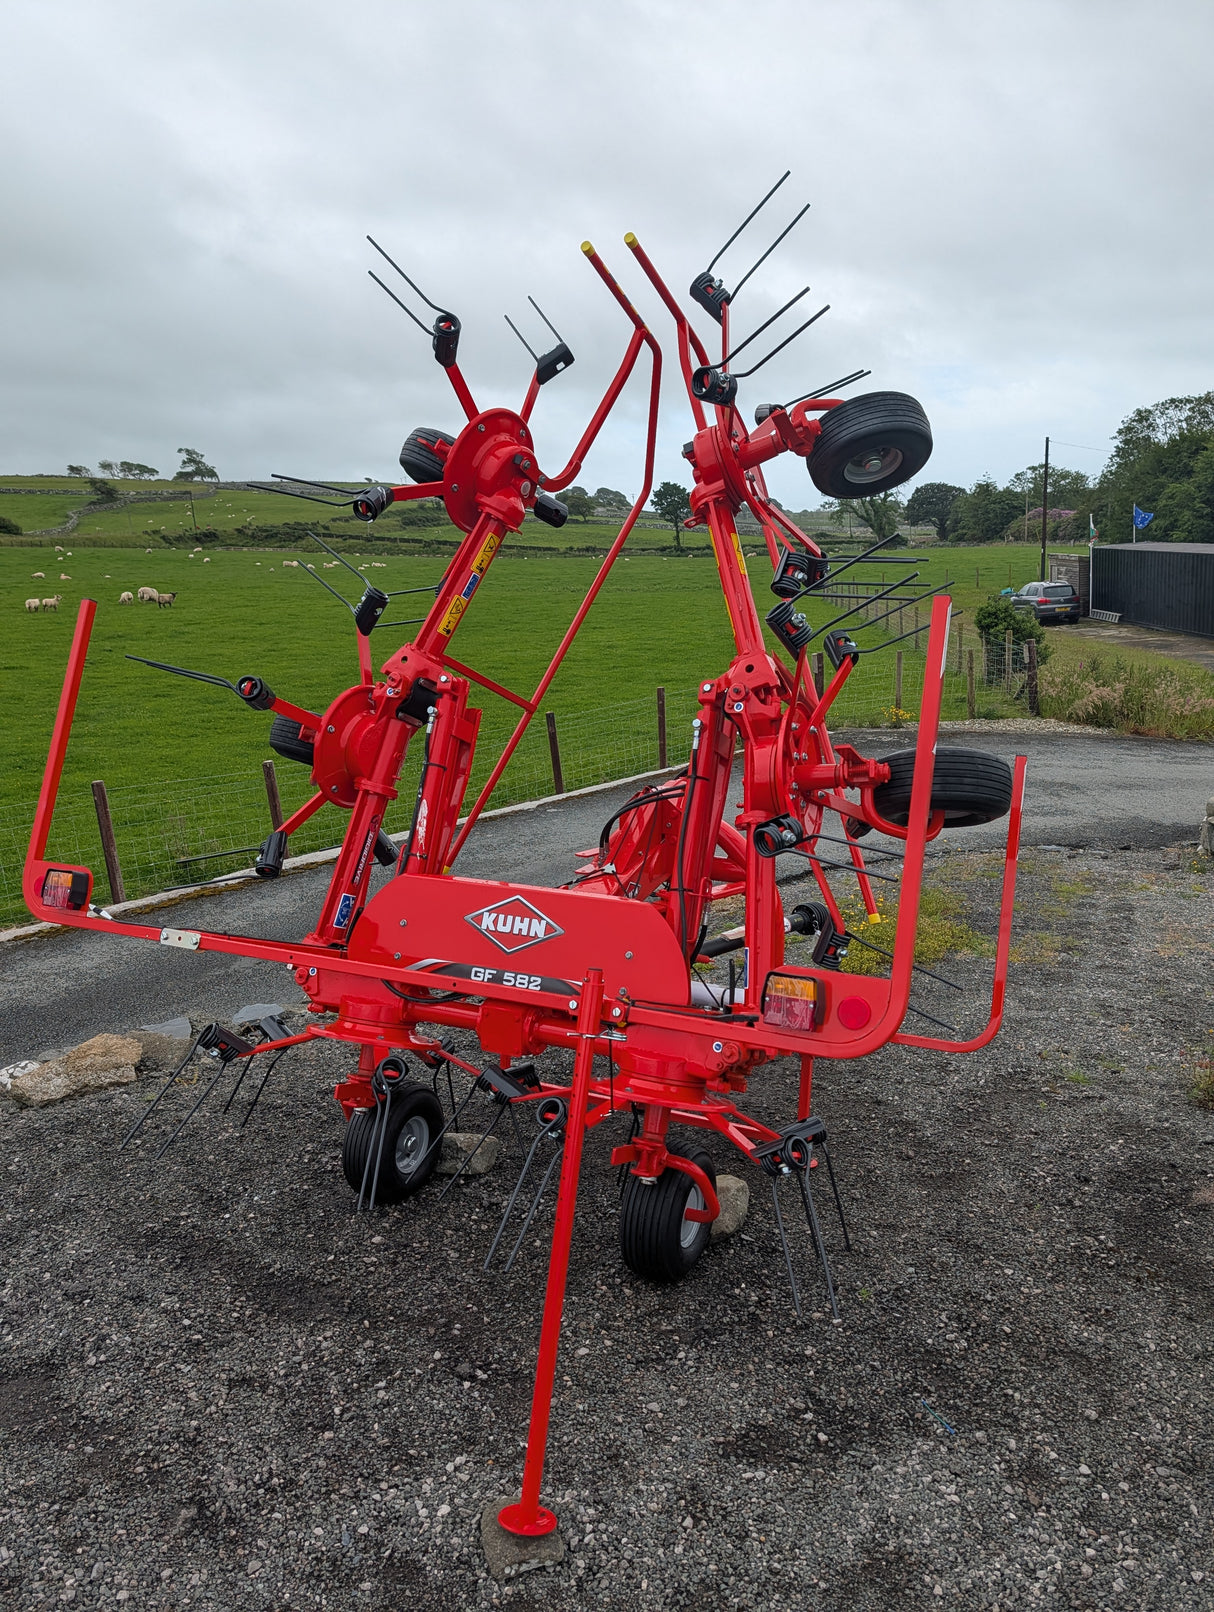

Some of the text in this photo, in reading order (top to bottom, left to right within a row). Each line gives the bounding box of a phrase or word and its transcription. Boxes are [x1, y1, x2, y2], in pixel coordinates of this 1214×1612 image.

[481, 911, 546, 938] KUHN
[470, 967, 541, 991] GF 582
